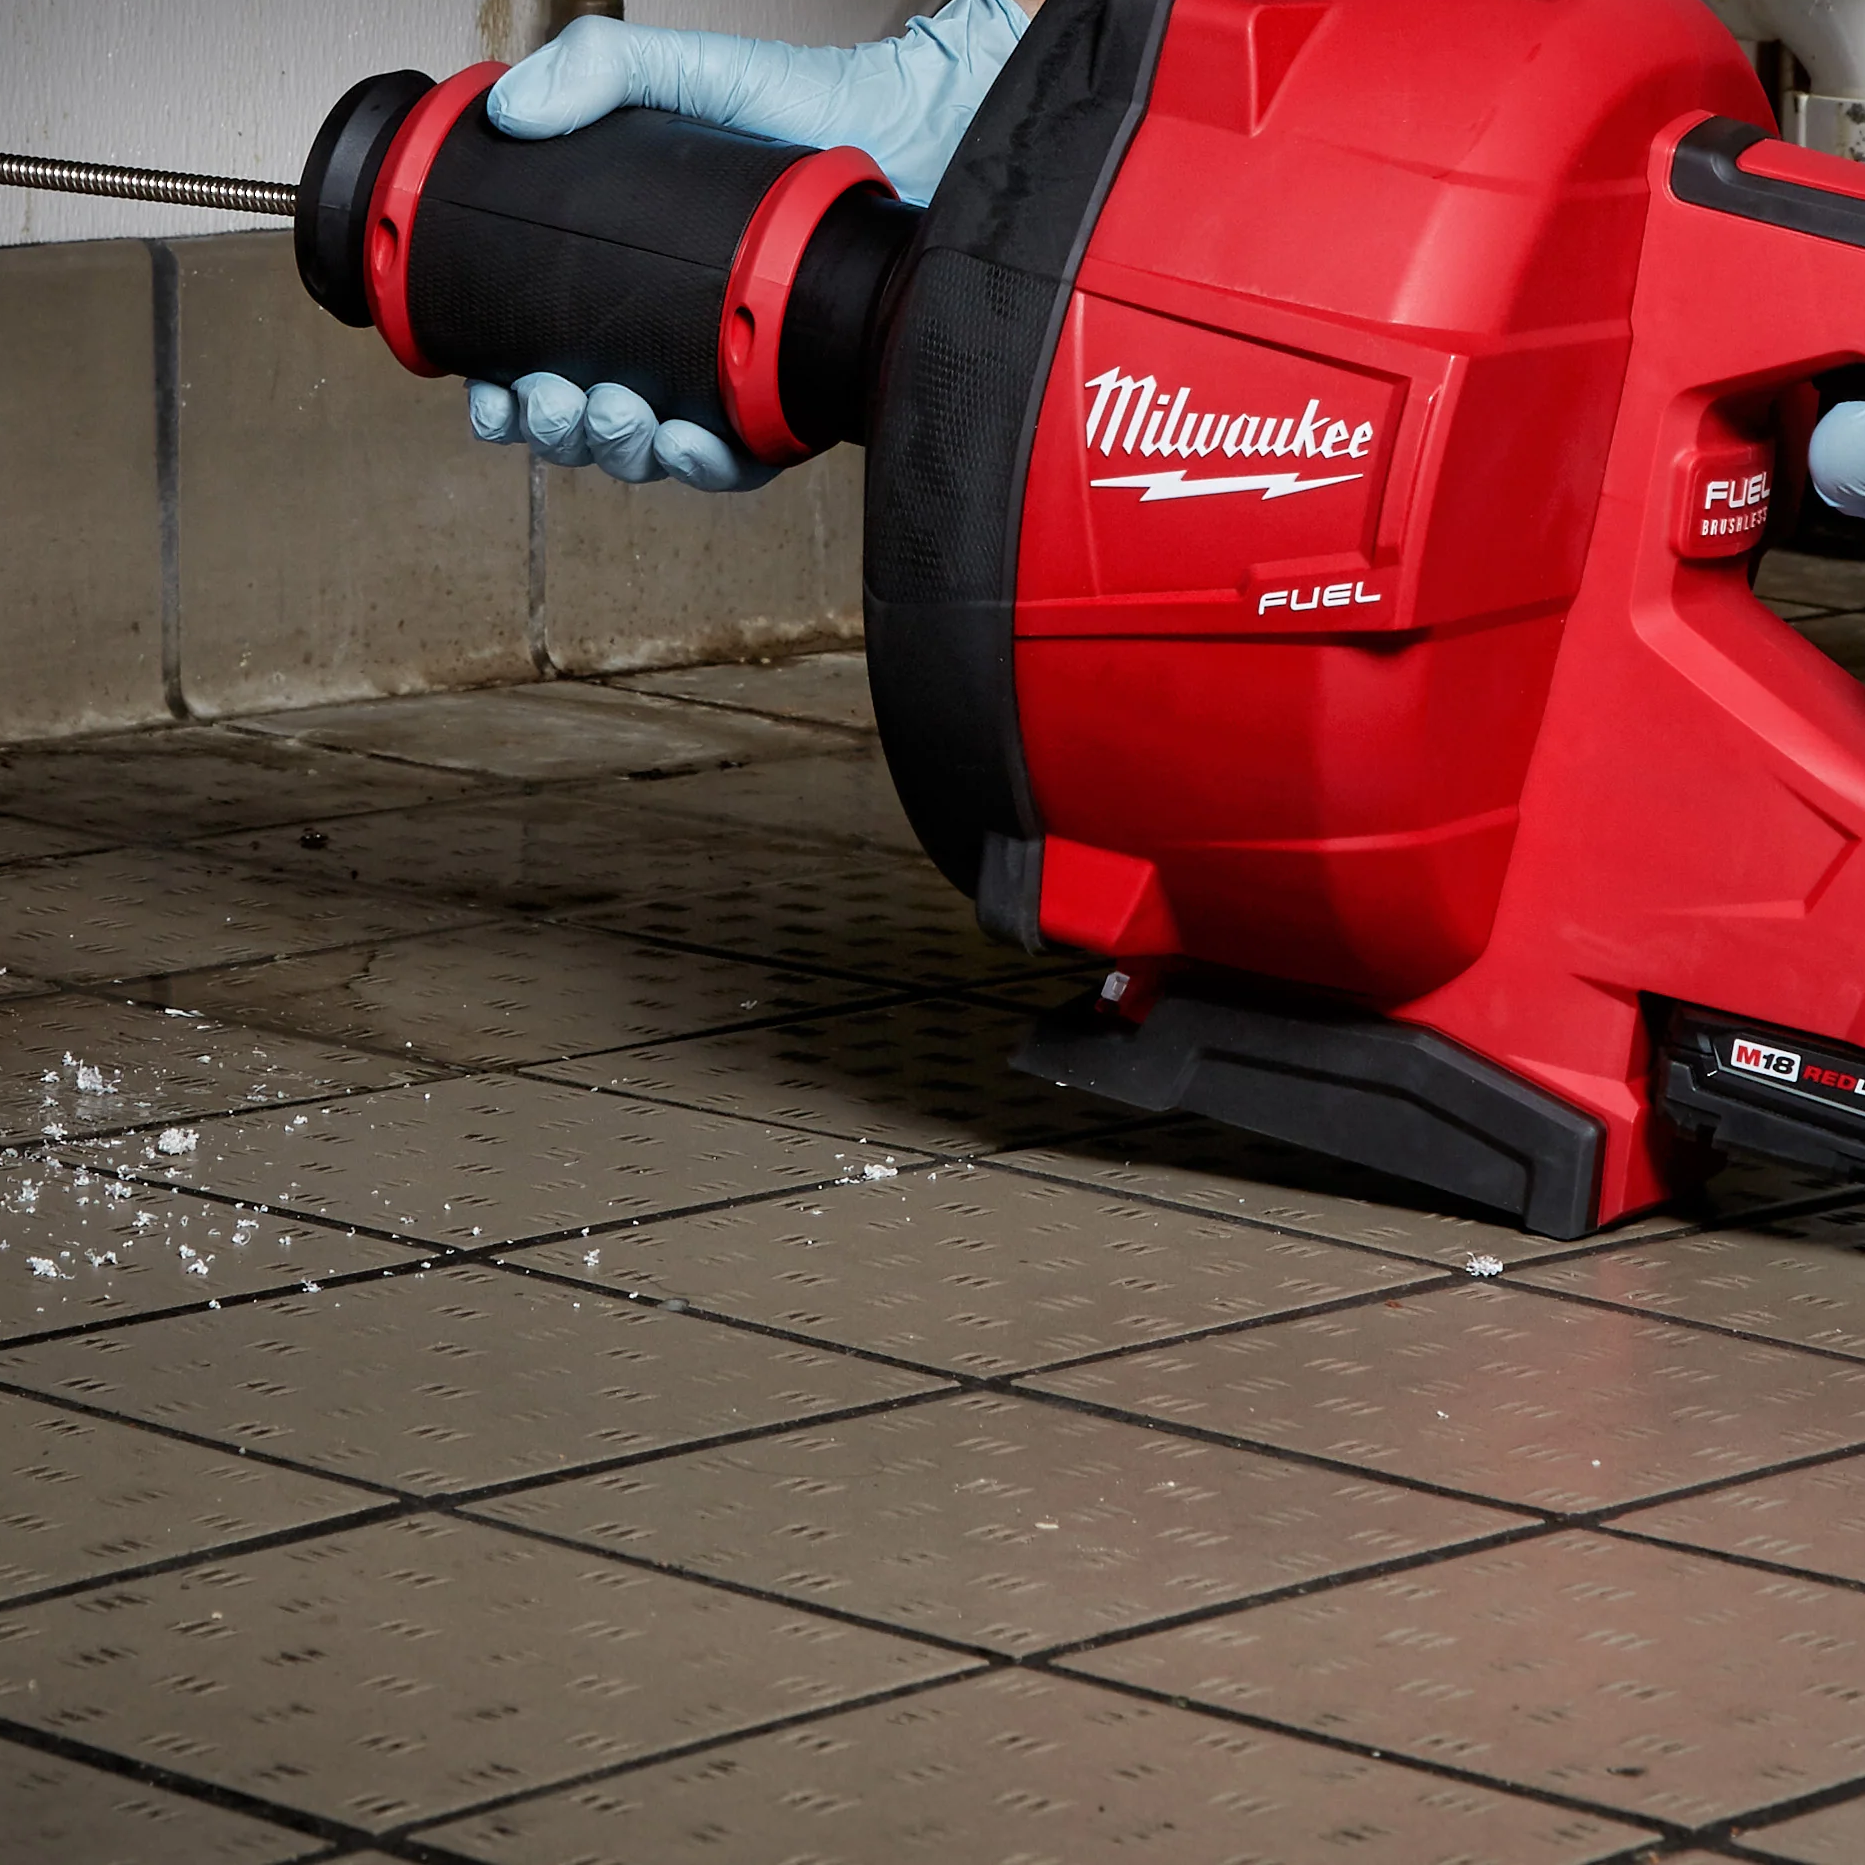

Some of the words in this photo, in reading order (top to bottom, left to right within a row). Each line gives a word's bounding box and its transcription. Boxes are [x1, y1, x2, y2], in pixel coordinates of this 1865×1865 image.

[1084, 366, 1374, 460] Milwaukee
[1704, 471, 1771, 510] FUEL
[1701, 506, 1768, 536] BRUSHLESS
[1258, 581, 1382, 616] FUEL
[1736, 1044, 1796, 1076] M18
